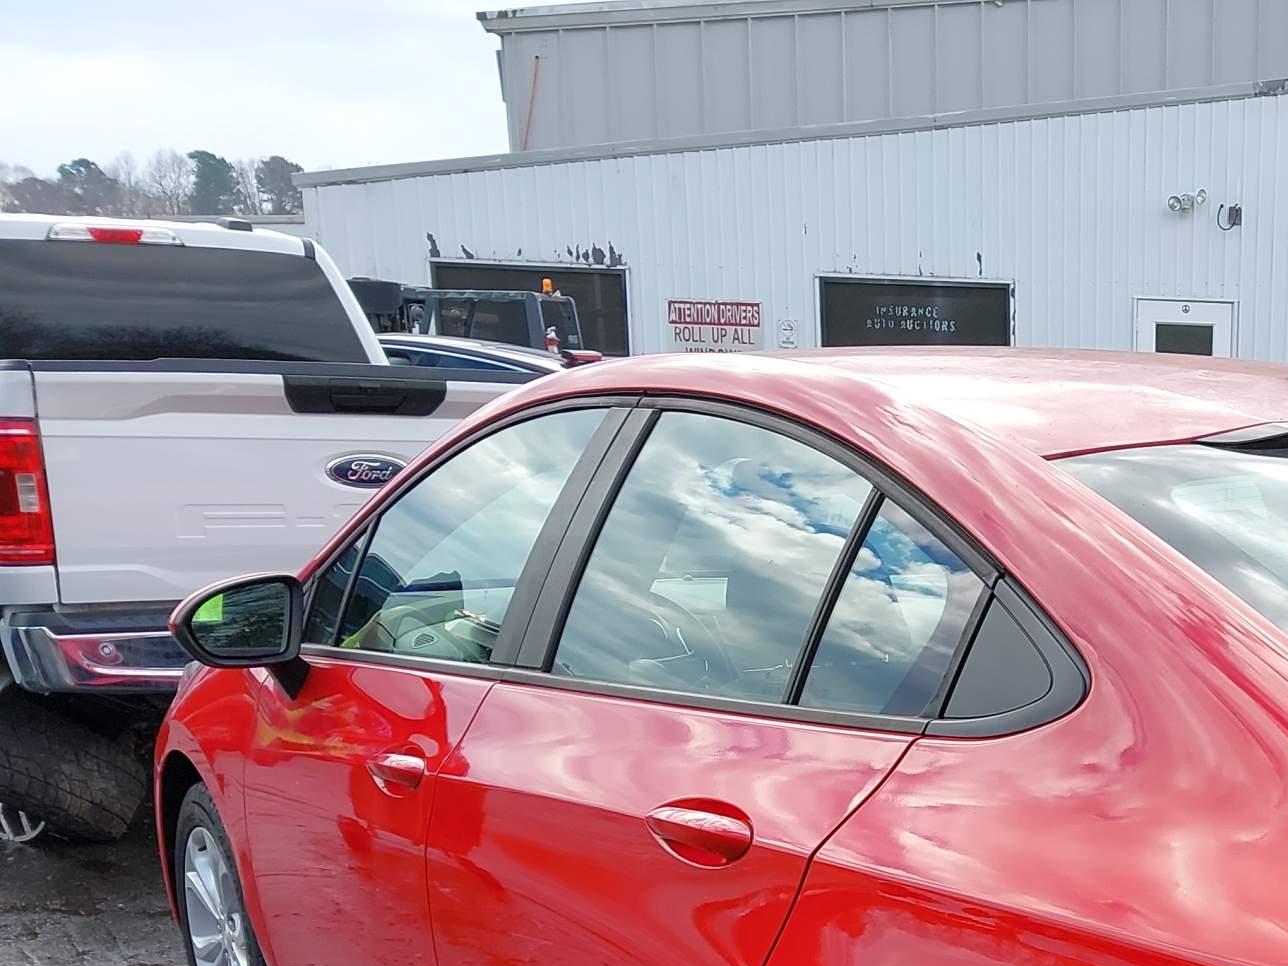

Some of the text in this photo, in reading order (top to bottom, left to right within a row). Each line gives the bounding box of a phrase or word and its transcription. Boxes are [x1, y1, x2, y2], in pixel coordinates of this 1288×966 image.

[669, 303, 759, 325] ATTENTION DRIVERS
[674, 326, 755, 344] ROLL UP ALL
[347, 461, 393, 480] Ford
